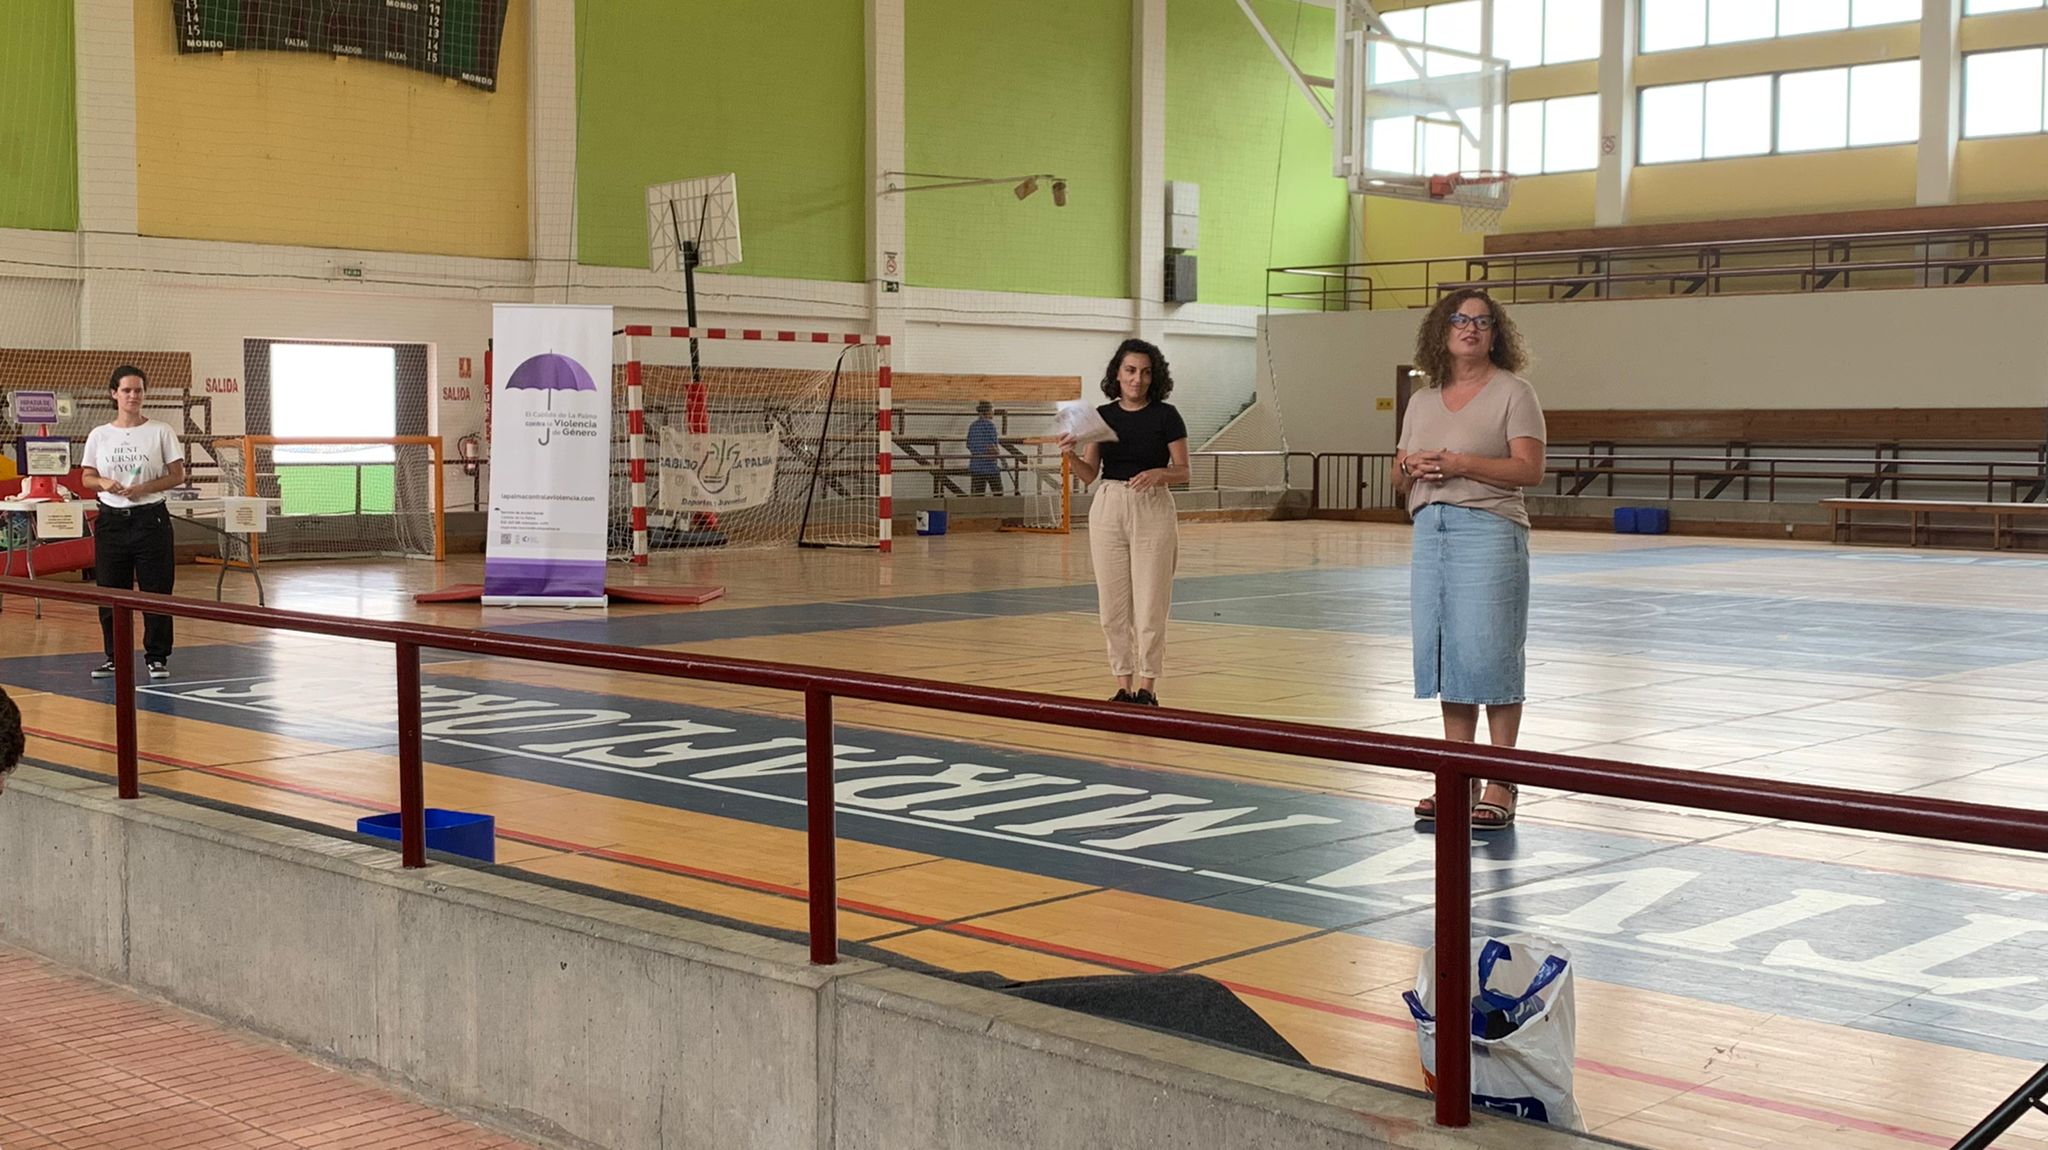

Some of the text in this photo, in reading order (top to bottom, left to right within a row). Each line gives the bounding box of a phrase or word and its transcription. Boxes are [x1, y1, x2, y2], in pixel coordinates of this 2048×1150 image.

[386, 0, 419, 11] MONDO
[186, 11, 199, 22] 14
[429, 16, 440, 27] 12
[188, 25, 200, 36] 15
[428, 28, 440, 38] 13
[186, 39, 223, 48] MONDO
[284, 37, 309, 48] FALTAS
[427, 40, 439, 51] 14
[385, 51, 408, 61] FALTAS
[427, 51, 438, 63] 15
[462, 72, 493, 85] MONDO
[205, 377, 238, 393] SALIDA
[443, 386, 471, 401] SALIDA
[554, 418, 597, 428] Violencia
[562, 427, 597, 437] Género
[105, 453, 150, 463] VERSION
